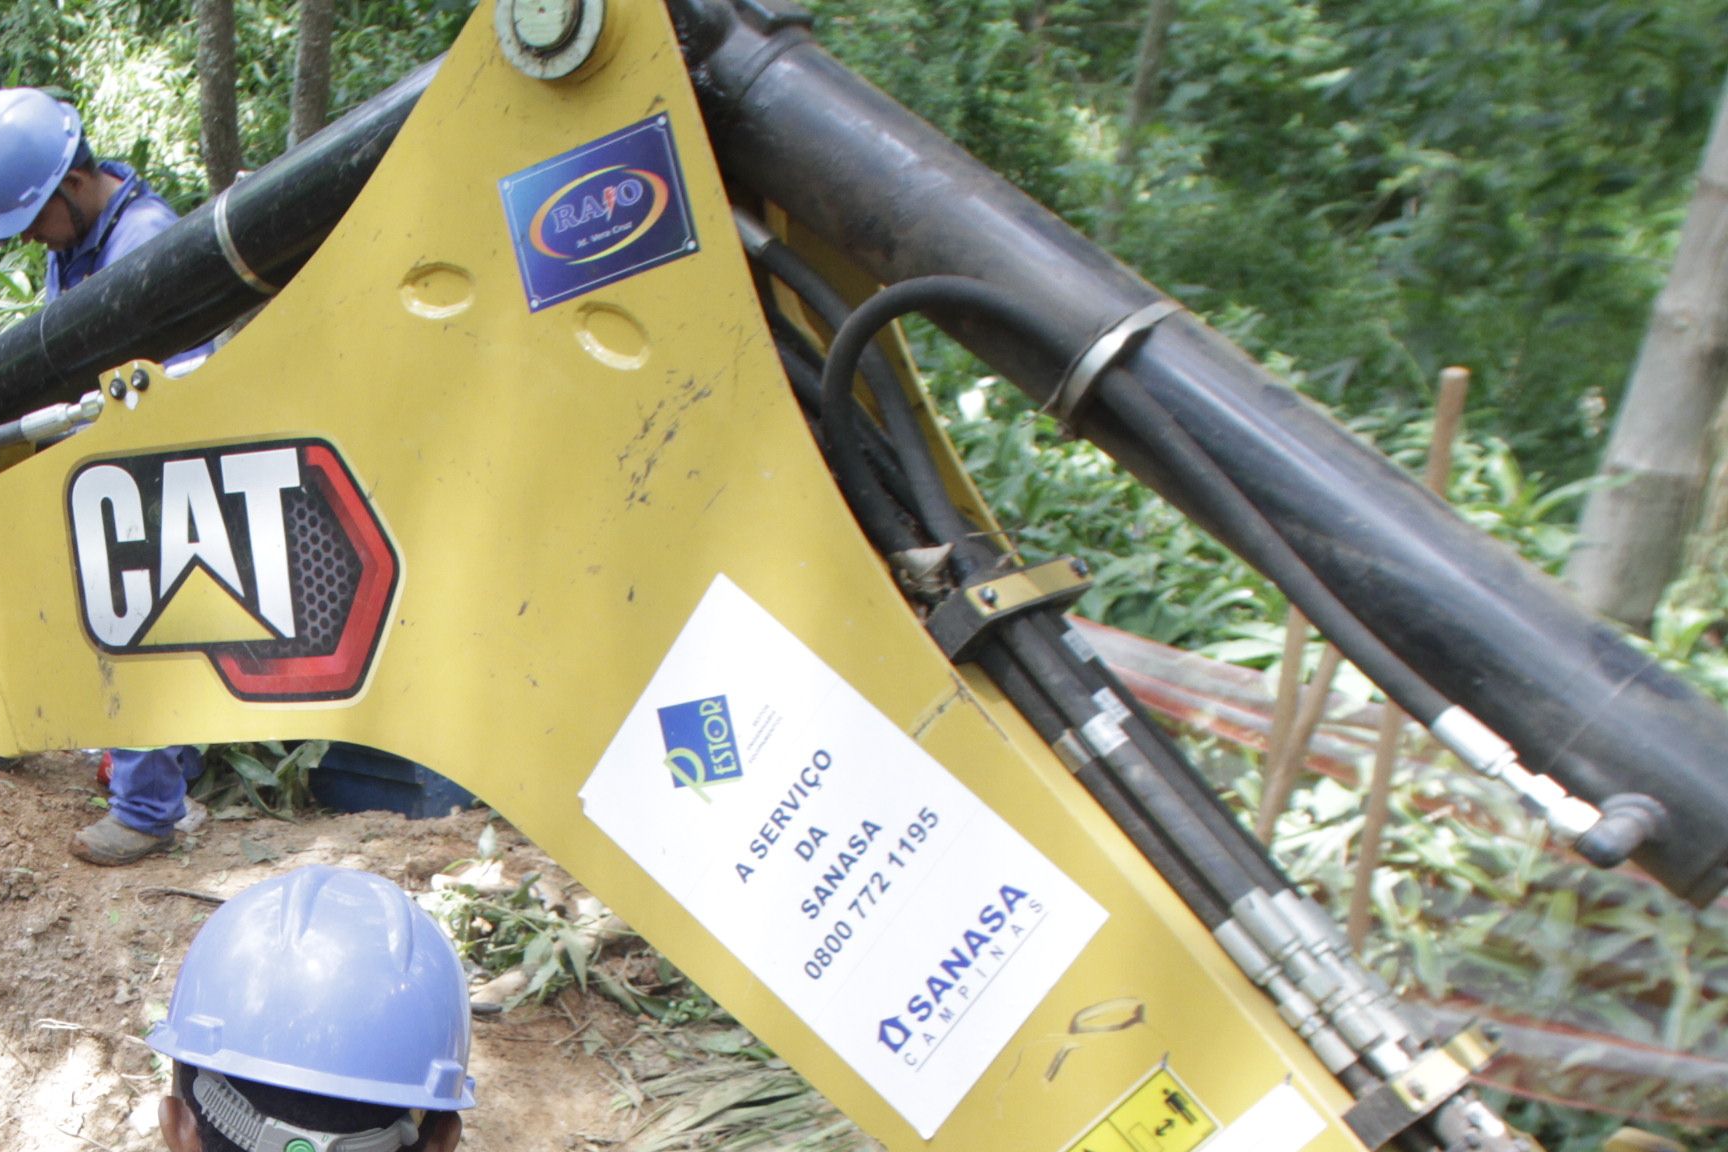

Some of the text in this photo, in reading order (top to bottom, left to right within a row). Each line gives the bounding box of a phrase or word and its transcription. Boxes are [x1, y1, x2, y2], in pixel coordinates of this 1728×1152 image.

[71, 447, 301, 647] CAT
[735, 862, 755, 884] A
[749, 749, 832, 860] SERVIÇO
[794, 825, 829, 862] DA
[800, 819, 883, 919] SANASA
[804, 806, 939, 980] 0800 772 1195
[907, 884, 1029, 1023] SANASA
[904, 899, 1044, 1066] CAMPINAS
